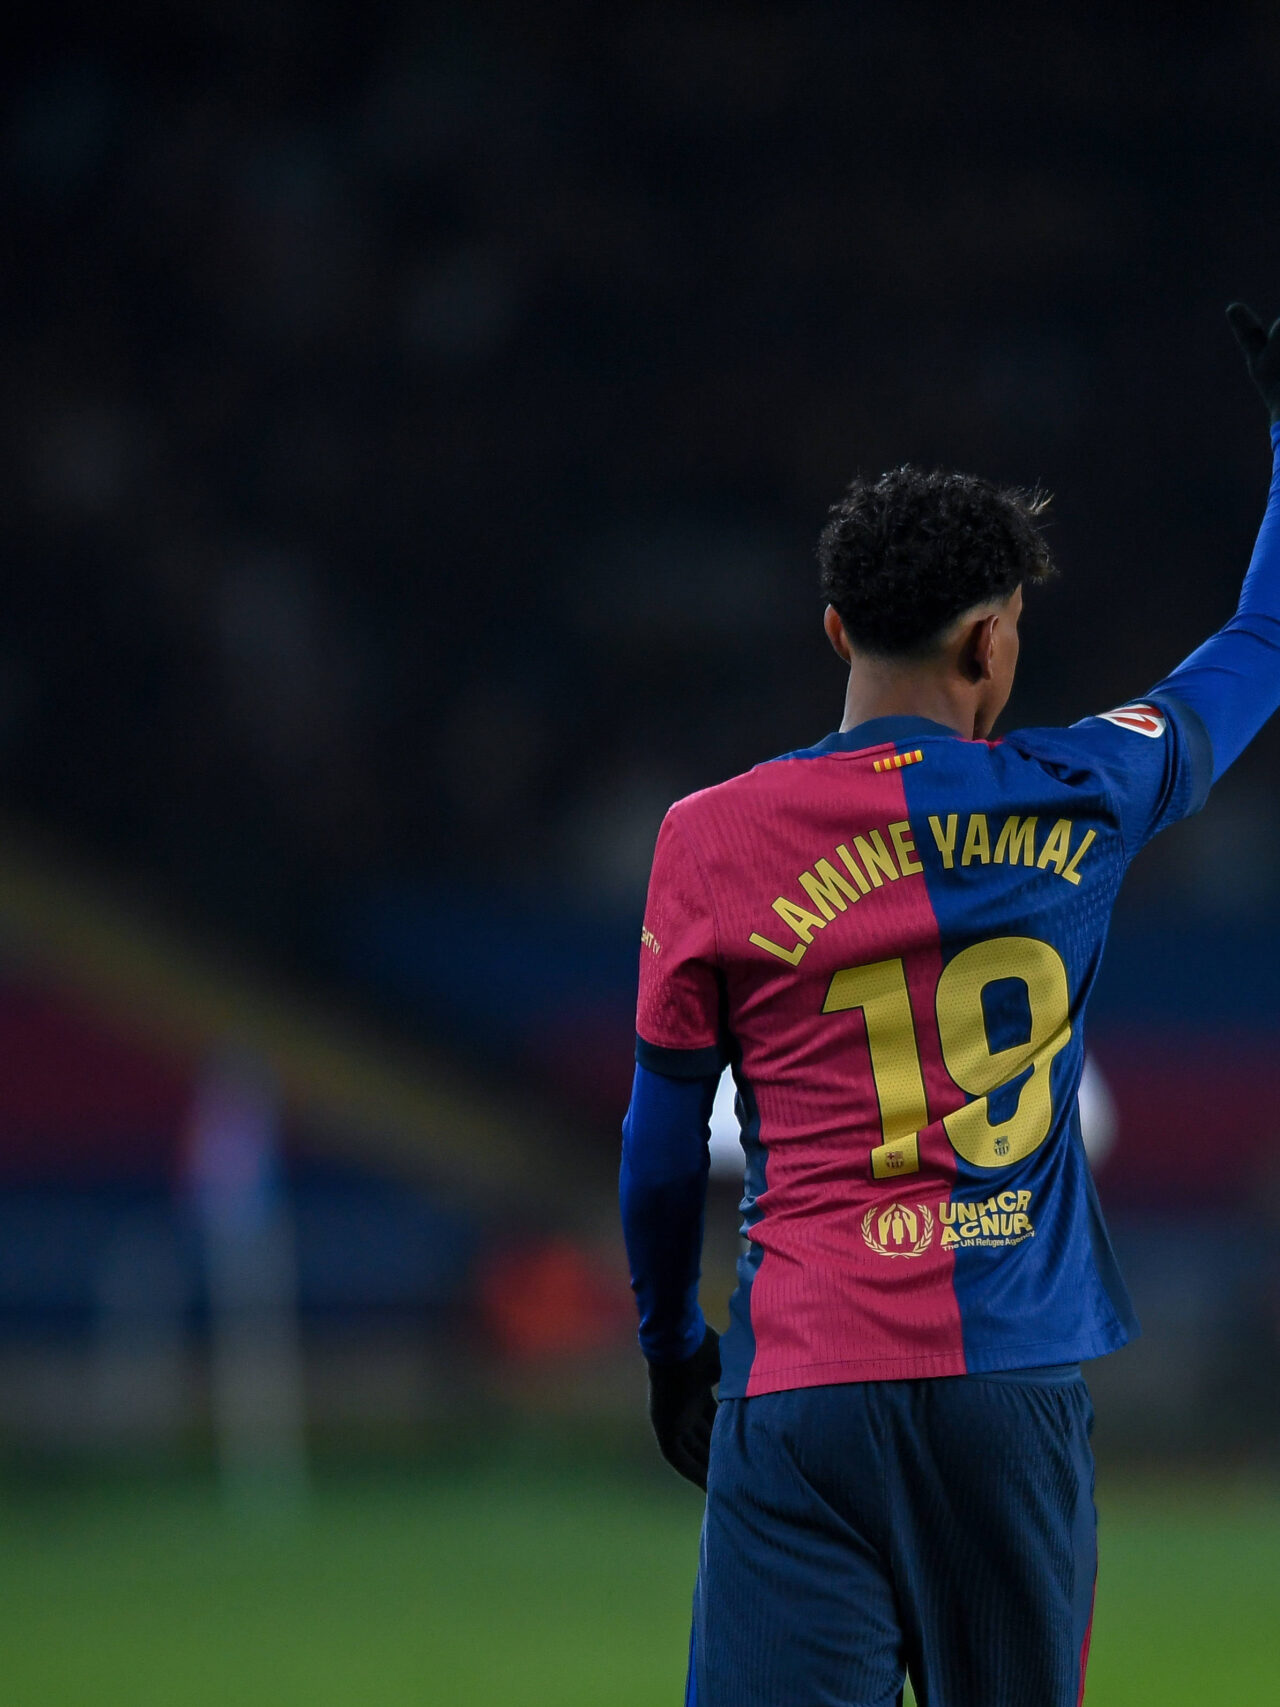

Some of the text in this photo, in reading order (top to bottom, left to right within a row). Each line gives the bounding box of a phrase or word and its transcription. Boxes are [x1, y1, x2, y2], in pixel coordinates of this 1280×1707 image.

[749, 813, 1097, 967] LAMINE YAMAL
[821, 936, 1074, 1180] 19
[939, 1190, 1032, 1224] UNHCR
[940, 1213, 1033, 1245] ACNUR
[943, 1231, 1035, 1252] The UN Refugee Agency
